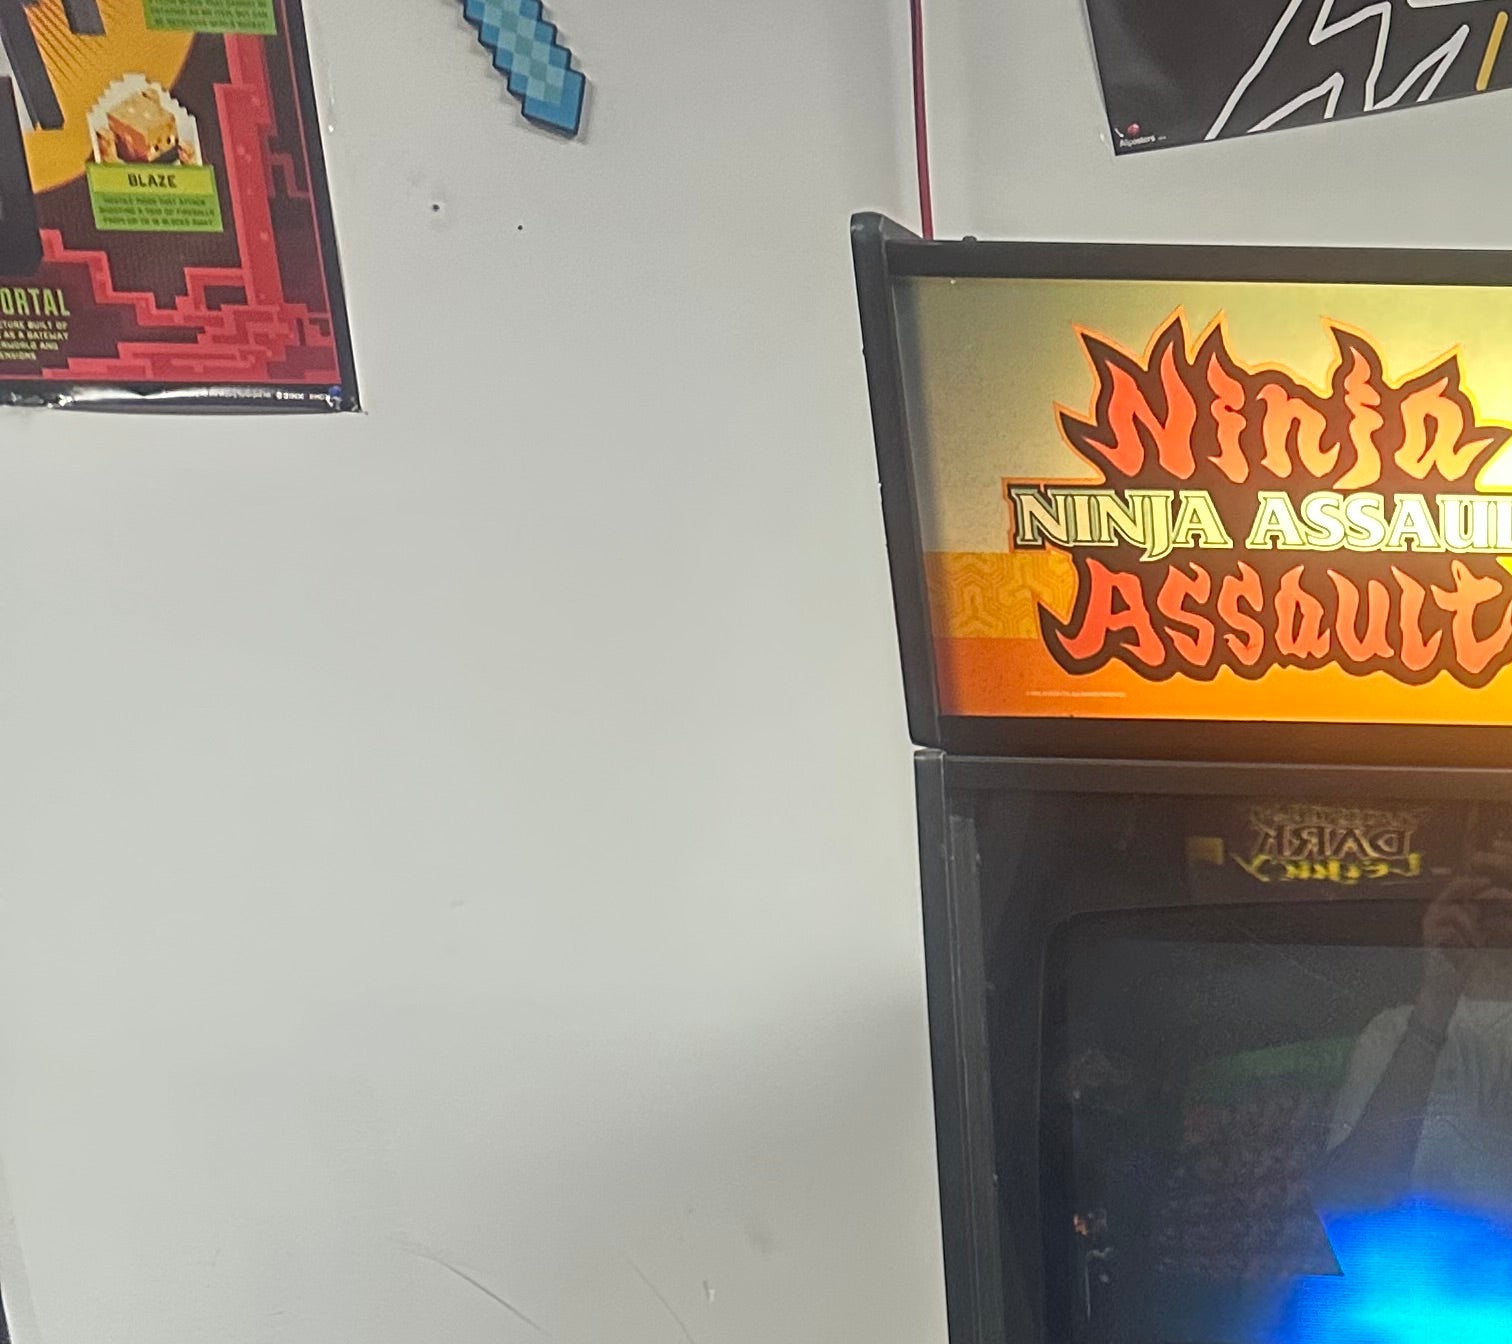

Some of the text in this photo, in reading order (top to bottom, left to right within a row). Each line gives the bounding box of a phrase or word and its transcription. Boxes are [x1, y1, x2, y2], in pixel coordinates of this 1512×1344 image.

[127, 173, 177, 188] BLAZE
[1080, 337, 1497, 490] Ninja
[1013, 488, 1233, 561] NINJA
